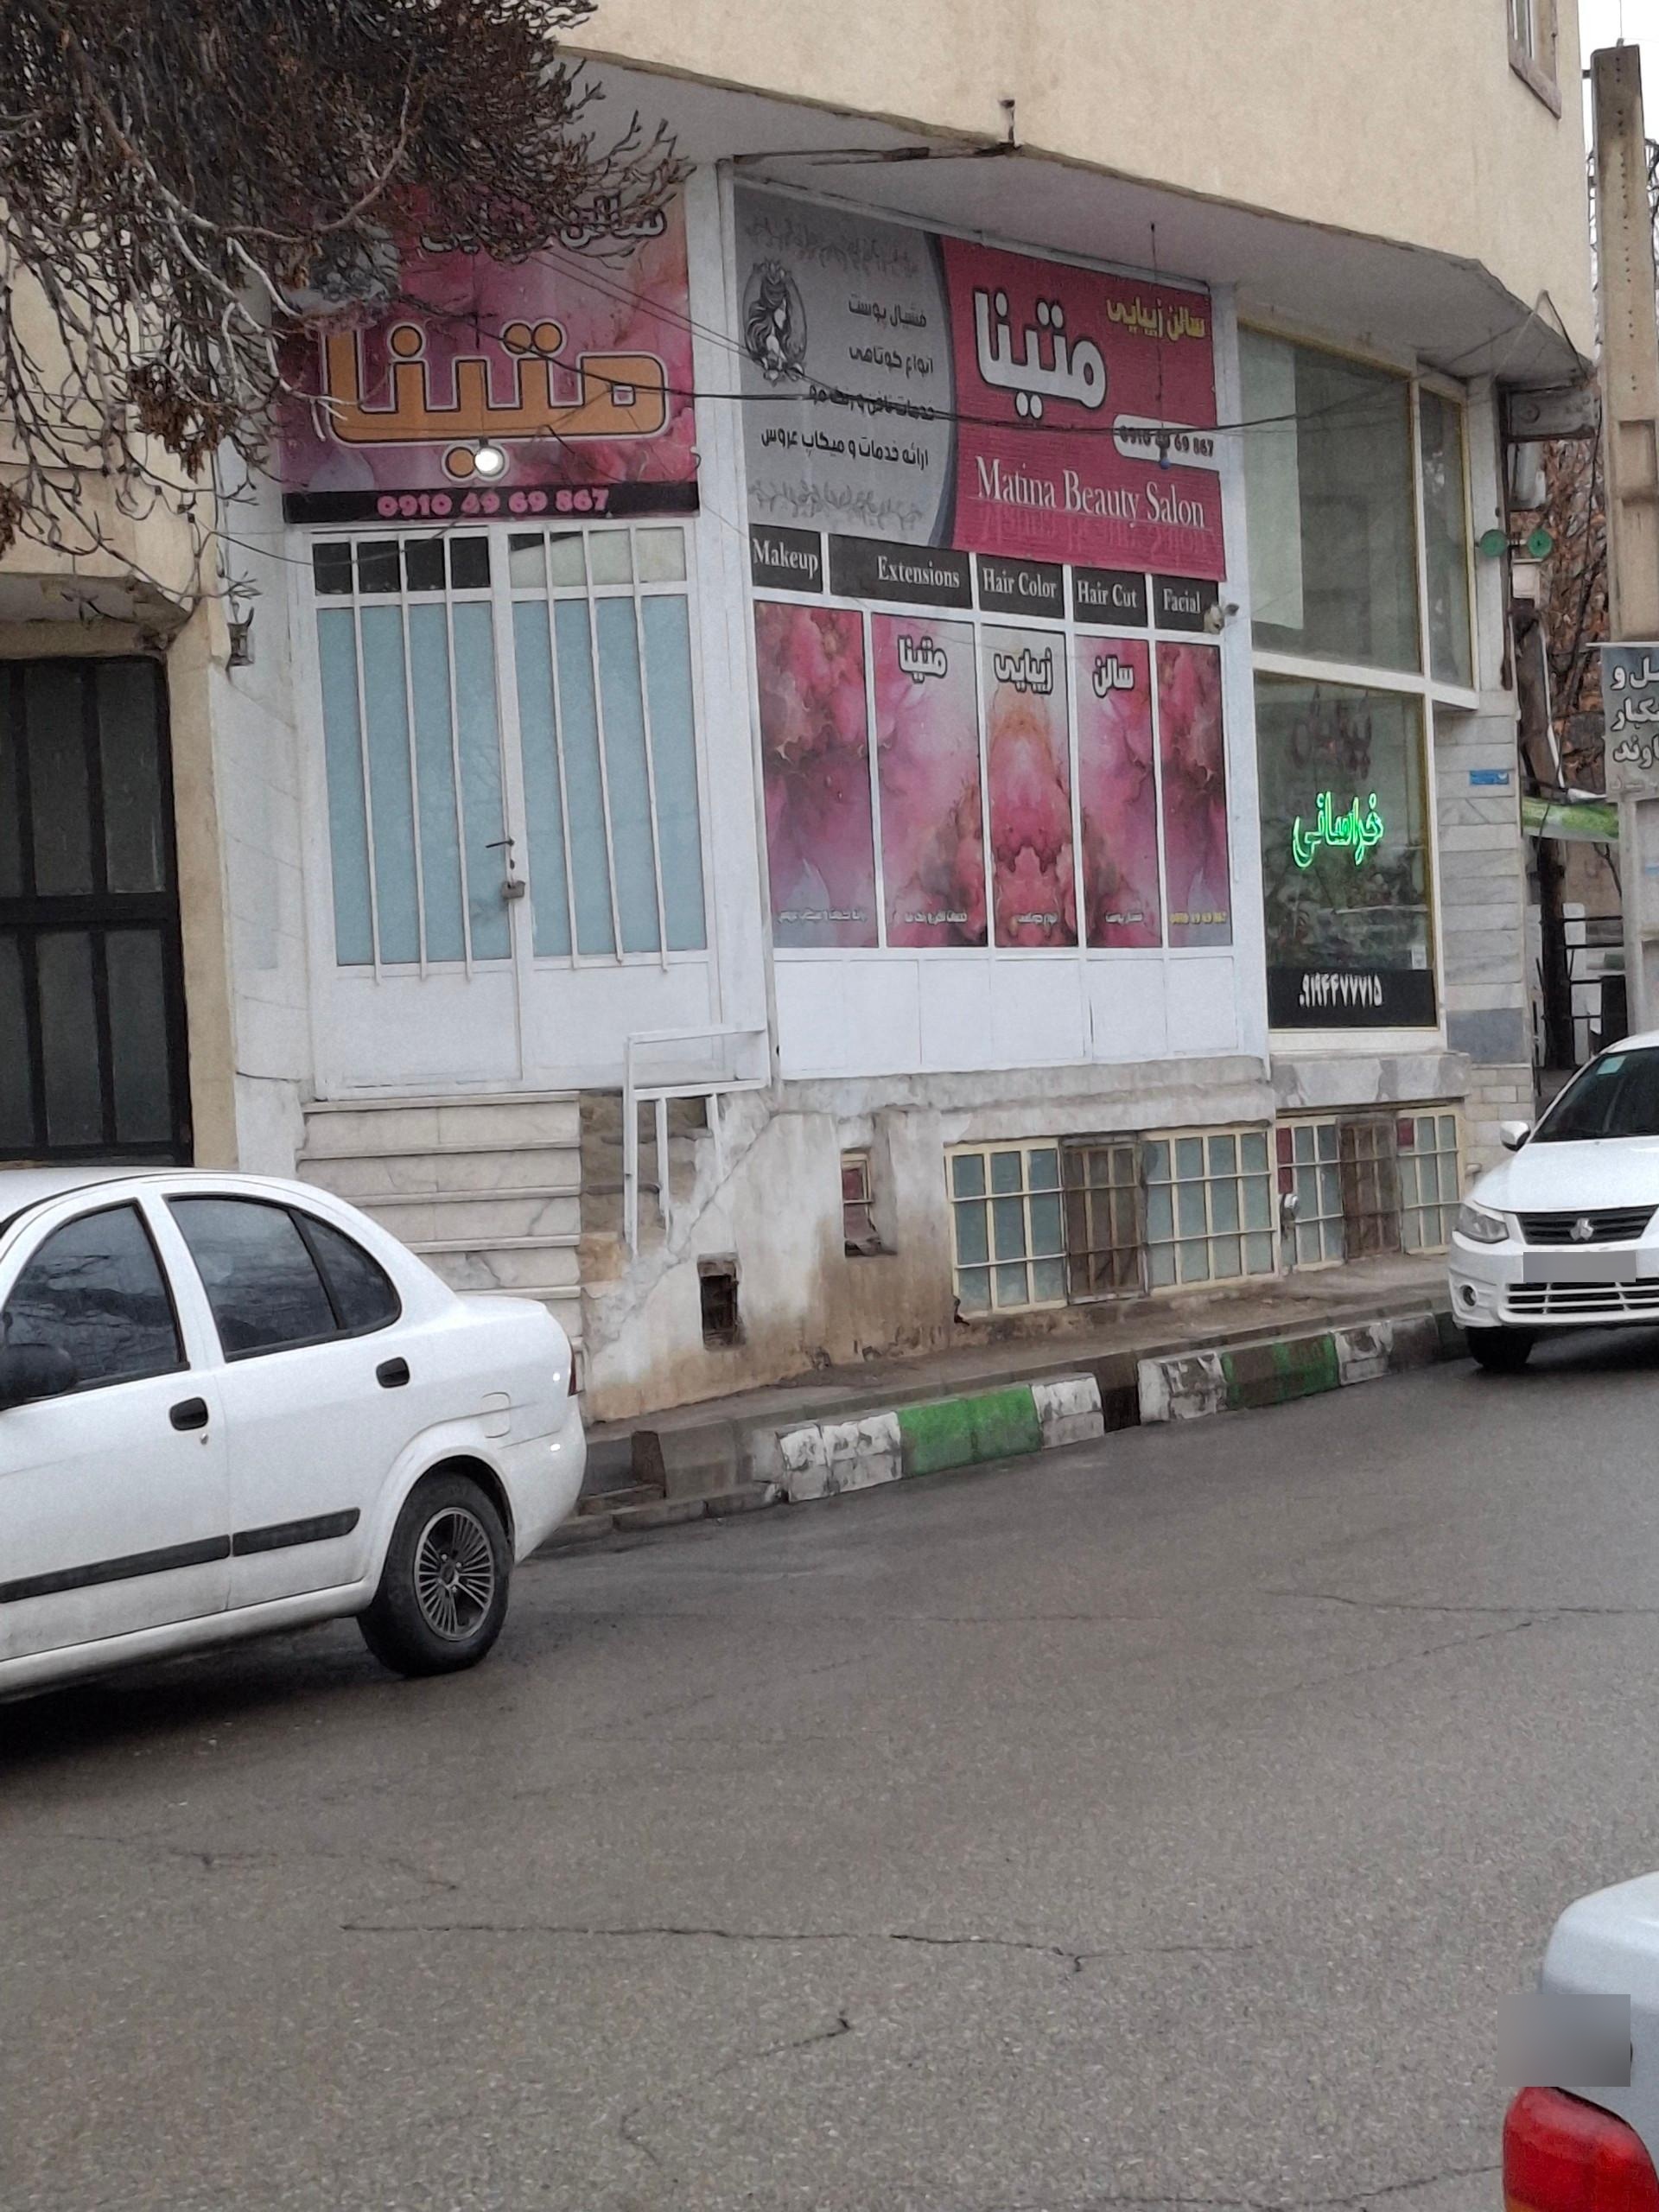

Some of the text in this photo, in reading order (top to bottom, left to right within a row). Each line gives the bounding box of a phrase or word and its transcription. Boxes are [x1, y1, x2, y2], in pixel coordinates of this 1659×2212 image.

[848, 293, 887, 330] پوست
[1107, 297, 1205, 341] سالن زیبایی
[849, 346, 903, 374] کوتاهی
[973, 289, 1107, 420] متینا
[320, 321, 670, 480] متینا
[761, 428, 929, 471] ارائه خدمات و میکاپ عروس
[377, 493, 453, 517] 0910
[508, 490, 548, 512] 69
[556, 487, 609, 512] 867
[976, 456, 1205, 529] Matina Beauty Salon
[752, 537, 819, 581] Makeup
[877, 556, 960, 588] Extensions
[982, 567, 1058, 599] Hair Color
[1077, 580, 1137, 608] Hair Cut
[1163, 588, 1201, 614] Facial
[897, 634, 1135, 698] سالن زیبایی متینا
[1611, 665, 1627, 690] و
[1611, 697, 1659, 731] کبار
[1612, 734, 1659, 770] اوند
[1292, 790, 1384, 868] خراسانی
